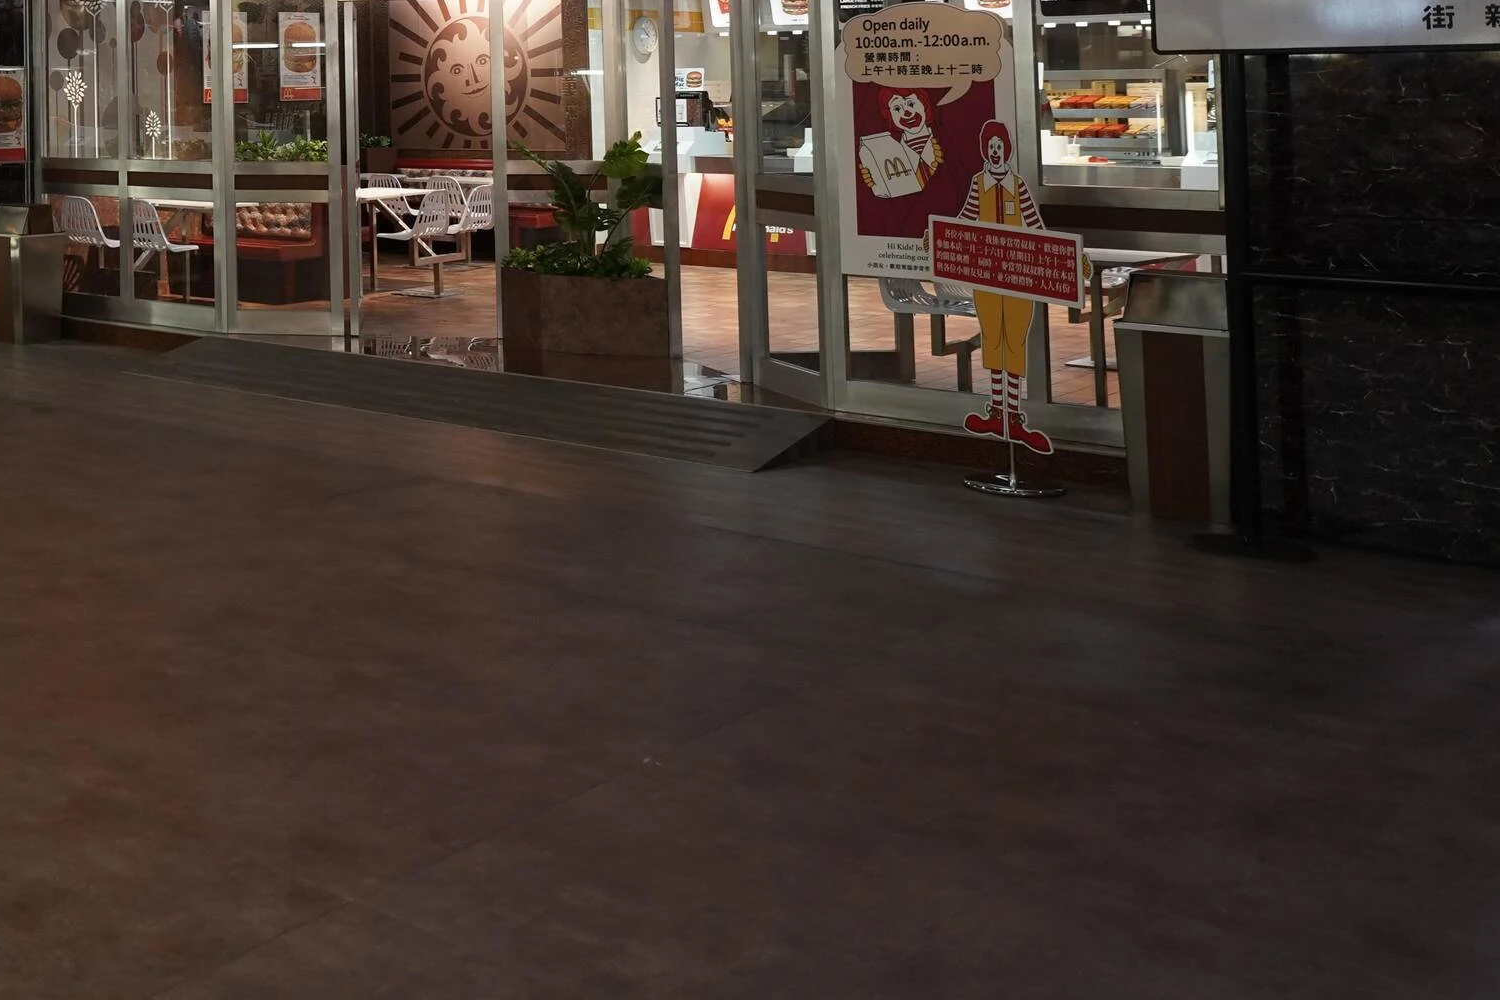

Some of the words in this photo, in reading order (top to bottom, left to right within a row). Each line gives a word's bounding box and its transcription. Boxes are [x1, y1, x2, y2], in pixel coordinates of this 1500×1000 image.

[862, 19, 896, 34] Open
[900, 17, 930, 33] daily
[861, 63, 983, 76] 上午十時至晚上十二時
[878, 252, 916, 262] celebrating
